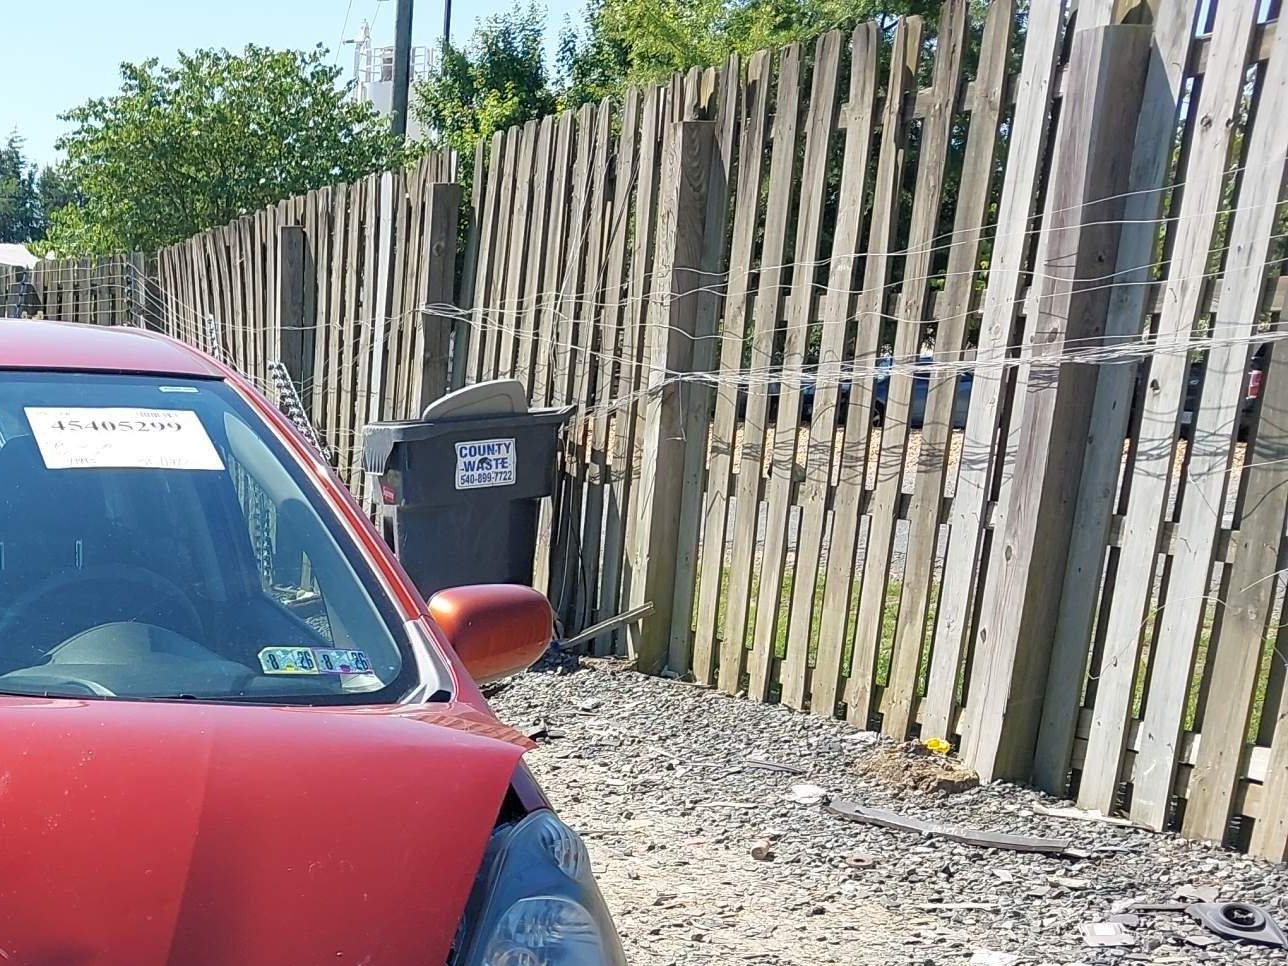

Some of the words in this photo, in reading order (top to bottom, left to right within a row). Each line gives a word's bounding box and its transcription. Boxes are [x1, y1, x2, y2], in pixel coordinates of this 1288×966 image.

[50, 420, 183, 432] 45405299
[459, 442, 512, 458] COUNTY
[463, 457, 509, 472] WASTE
[296, 651, 314, 669] 26
[351, 652, 369, 670] 26
